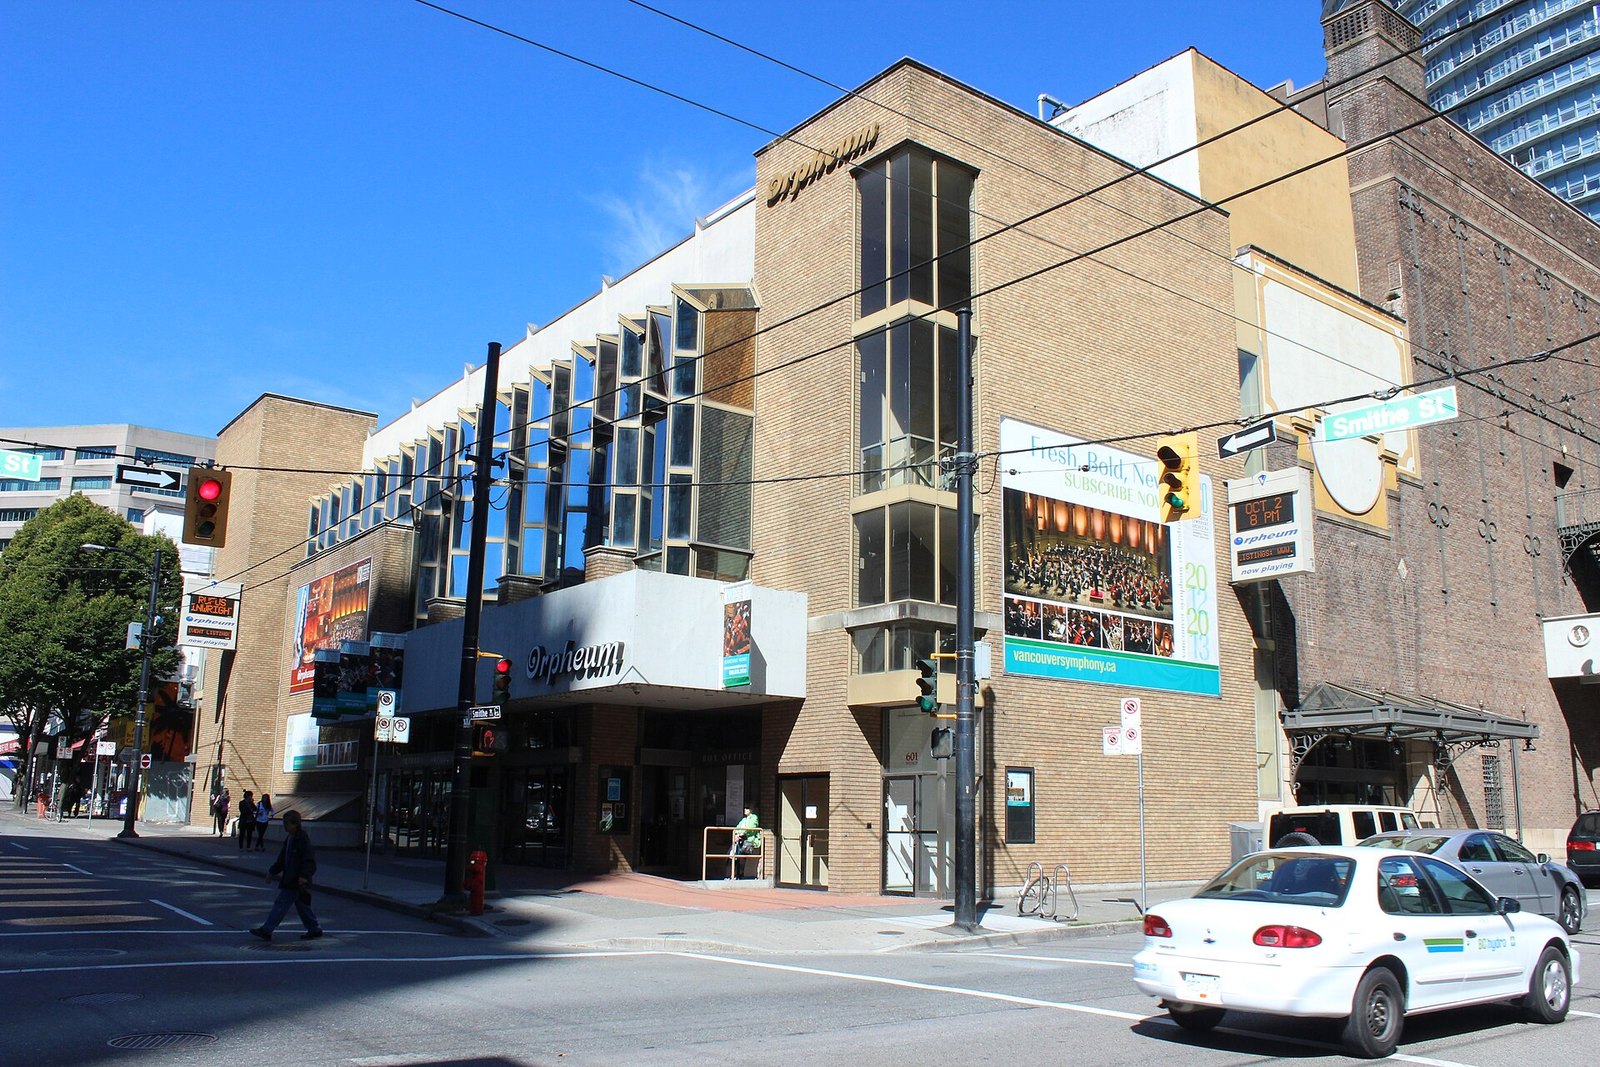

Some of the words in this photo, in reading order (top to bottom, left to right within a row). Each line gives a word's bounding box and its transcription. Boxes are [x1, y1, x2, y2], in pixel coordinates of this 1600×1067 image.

[1333, 407, 1409, 437] Smithe
[1418, 396, 1447, 418] St
[4, 454, 30, 474] St
[1087, 451, 1128, 484] Bold,
[1064, 472, 1134, 503] SUBSCRIBE
[1245, 500, 1267, 515] OCT
[1274, 496, 1282, 510] 2
[1249, 514, 1258, 526] 8
[1264, 510, 1280, 524] PM
[1234, 528, 1298, 546] Orpheum
[1185, 562, 1207, 591] 20
[1241, 567, 1259, 575] now
[1261, 562, 1293, 573] playing
[198, 596, 227, 607] RUFUS
[186, 616, 235, 627] Orpheum
[1187, 607, 1209, 637] 20
[204, 639, 229, 647] playing
[527, 641, 622, 686] Orpheum
[1013, 649, 1116, 674] vancouversymphony.ca
[905, 751, 918, 761] 601
